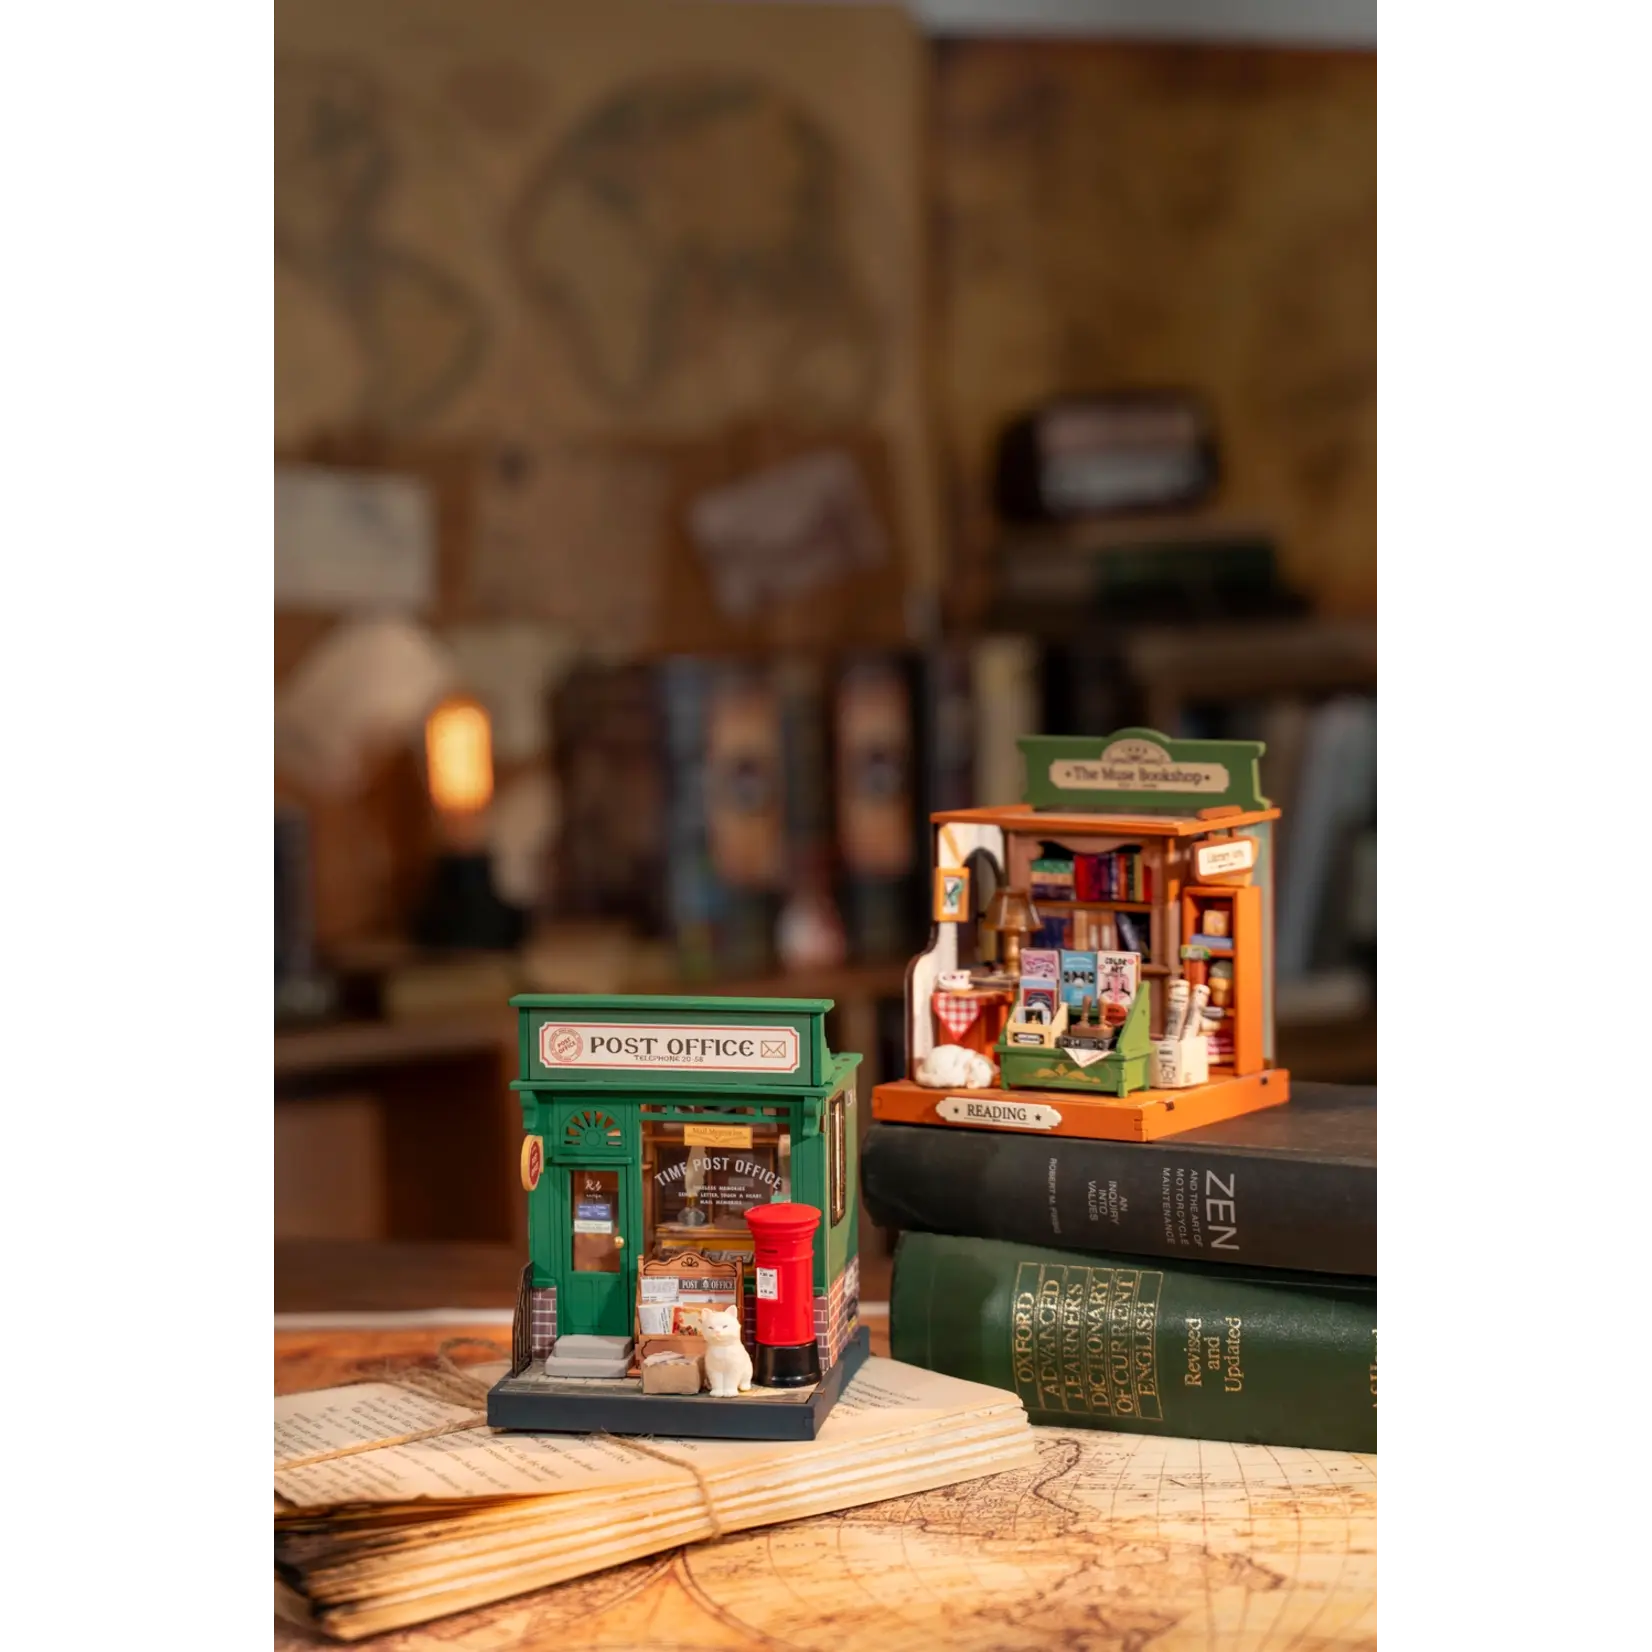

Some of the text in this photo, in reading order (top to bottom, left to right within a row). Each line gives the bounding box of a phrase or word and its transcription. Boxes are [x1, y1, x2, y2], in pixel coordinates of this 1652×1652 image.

[1072, 765, 1099, 781] The
[1139, 768, 1203, 786] Bookshop
[590, 1036, 755, 1057] POST OFFICE
[967, 1104, 1027, 1121] READING
[654, 1157, 784, 1190] TIME POST OFFICE
[1189, 1169, 1198, 1190] AND
[1088, 1180, 1098, 1221] VALUES
[1099, 1189, 1107, 1216] INTO
[1108, 1180, 1120, 1225] INQUIRY
[1119, 1196, 1128, 1212] AN
[1161, 1167, 1175, 1245] MAINTENANCE
[1175, 1168, 1189, 1245] MOTORCYCLE
[1190, 1191, 1198, 1213] THE
[1205, 1169, 1240, 1250] ZEN
[682, 1280, 734, 1289] POST OFFICE
[1015, 1291, 1034, 1383] OXFORD
[1038, 1279, 1061, 1398] ADVANCED
[1063, 1283, 1084, 1399] LEARNER'S
[1087, 1276, 1110, 1407] DICTIONARY
[1110, 1276, 1134, 1413] OF CURRENT
[1135, 1301, 1156, 1397] ENGLISH
[1184, 1317, 1202, 1388] Revised
[1204, 1336, 1221, 1371] and
[1224, 1315, 1245, 1393] Updated
